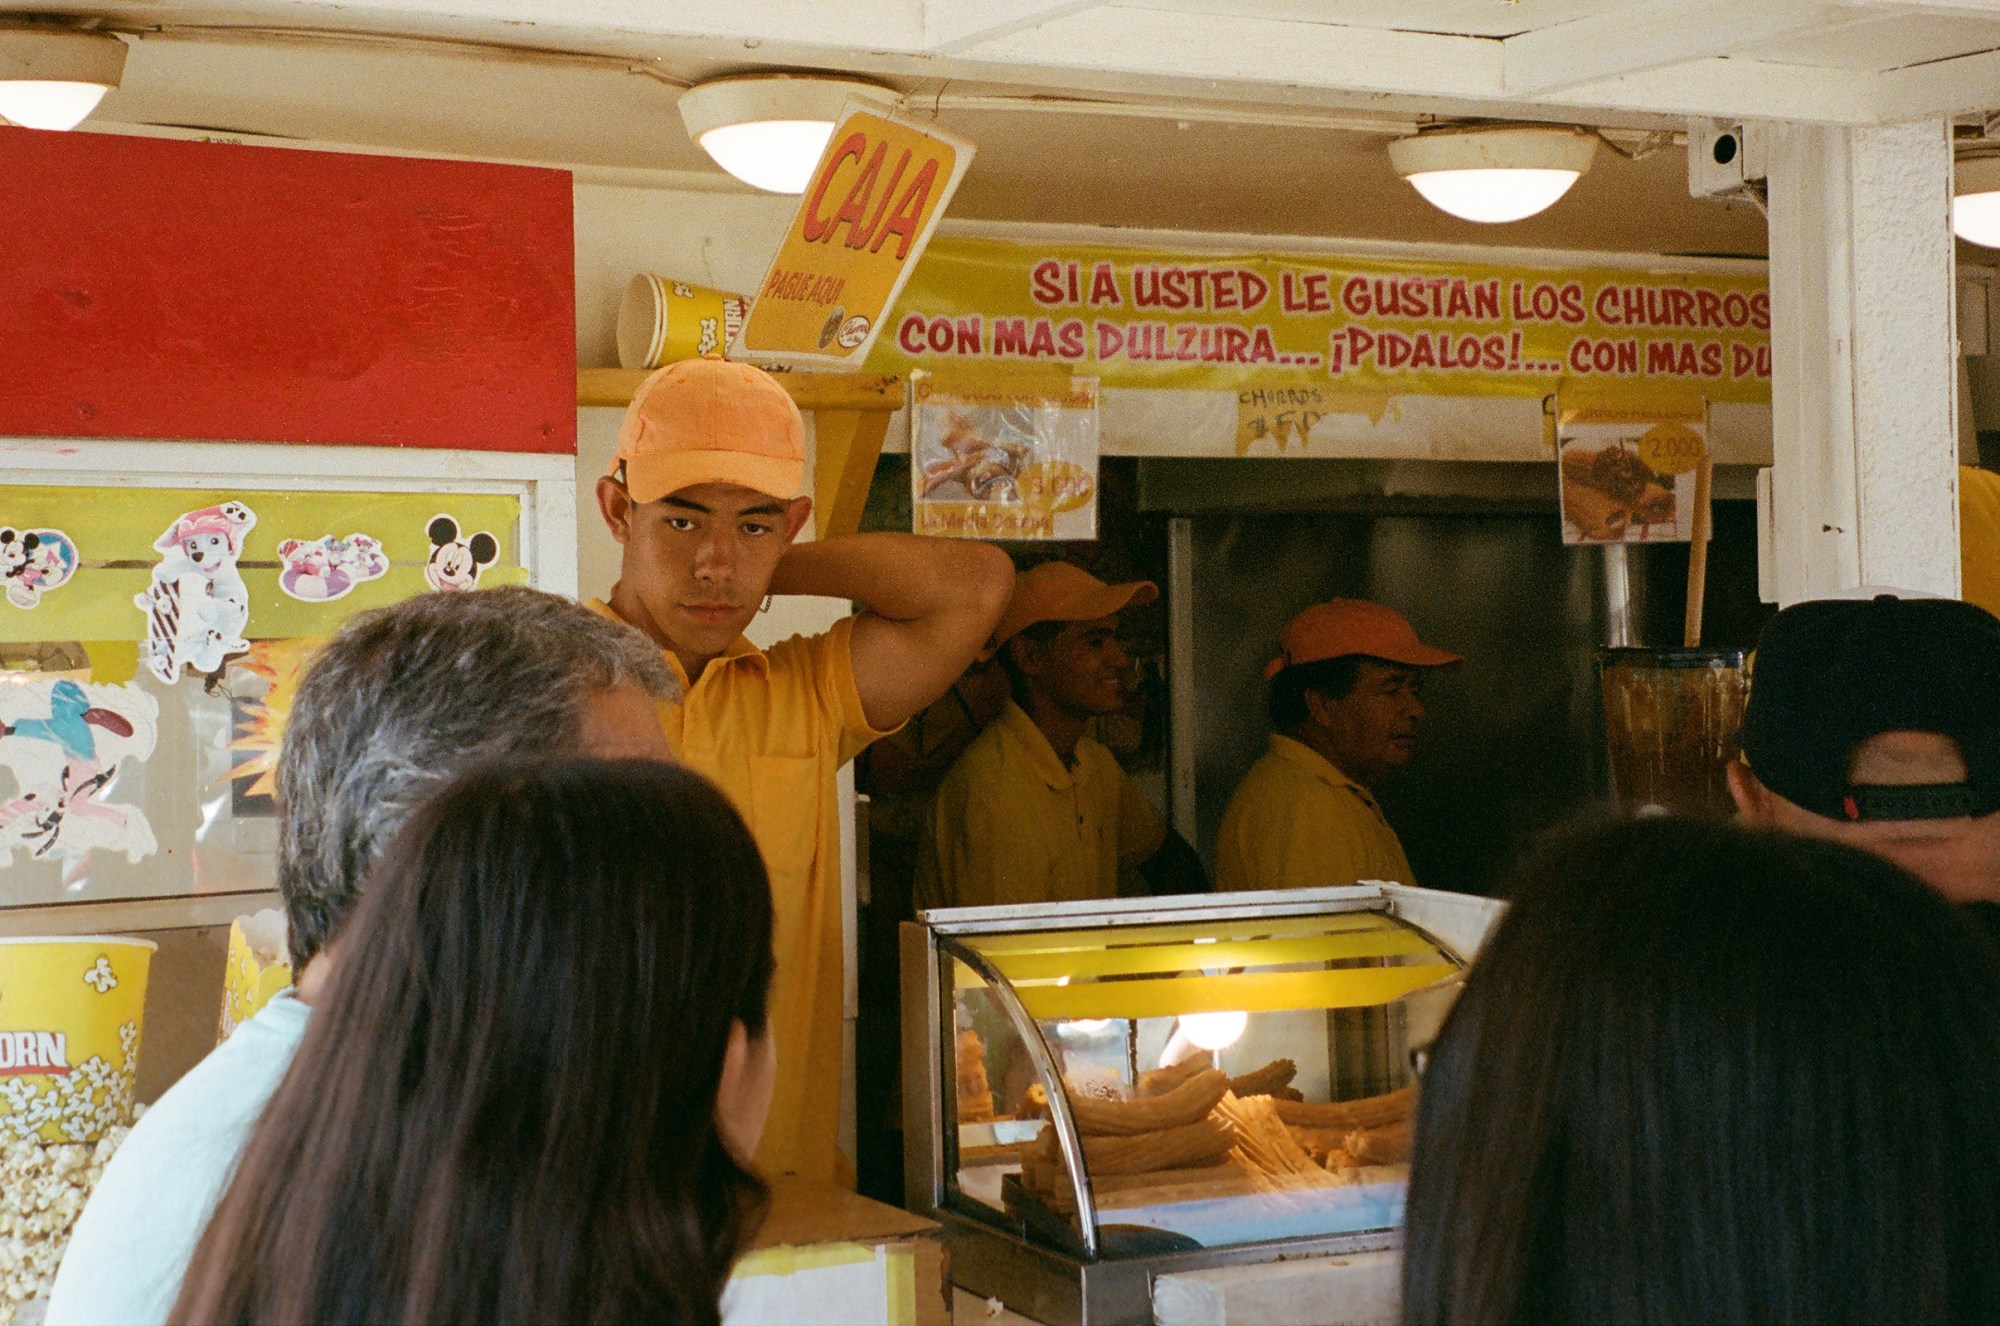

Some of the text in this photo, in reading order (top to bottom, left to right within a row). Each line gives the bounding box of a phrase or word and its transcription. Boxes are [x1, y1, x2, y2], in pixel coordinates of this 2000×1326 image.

[802, 131, 940, 260] CAJA
[764, 268, 846, 307] PAGUE AQUI
[1034, 261, 1770, 331] SI A USTED LE GUSTAN LOS CHURROS
[899, 316, 981, 355] CON
[993, 318, 1084, 360] MAS
[1570, 340, 1637, 373] CON
[1647, 344, 1723, 378] MAS
